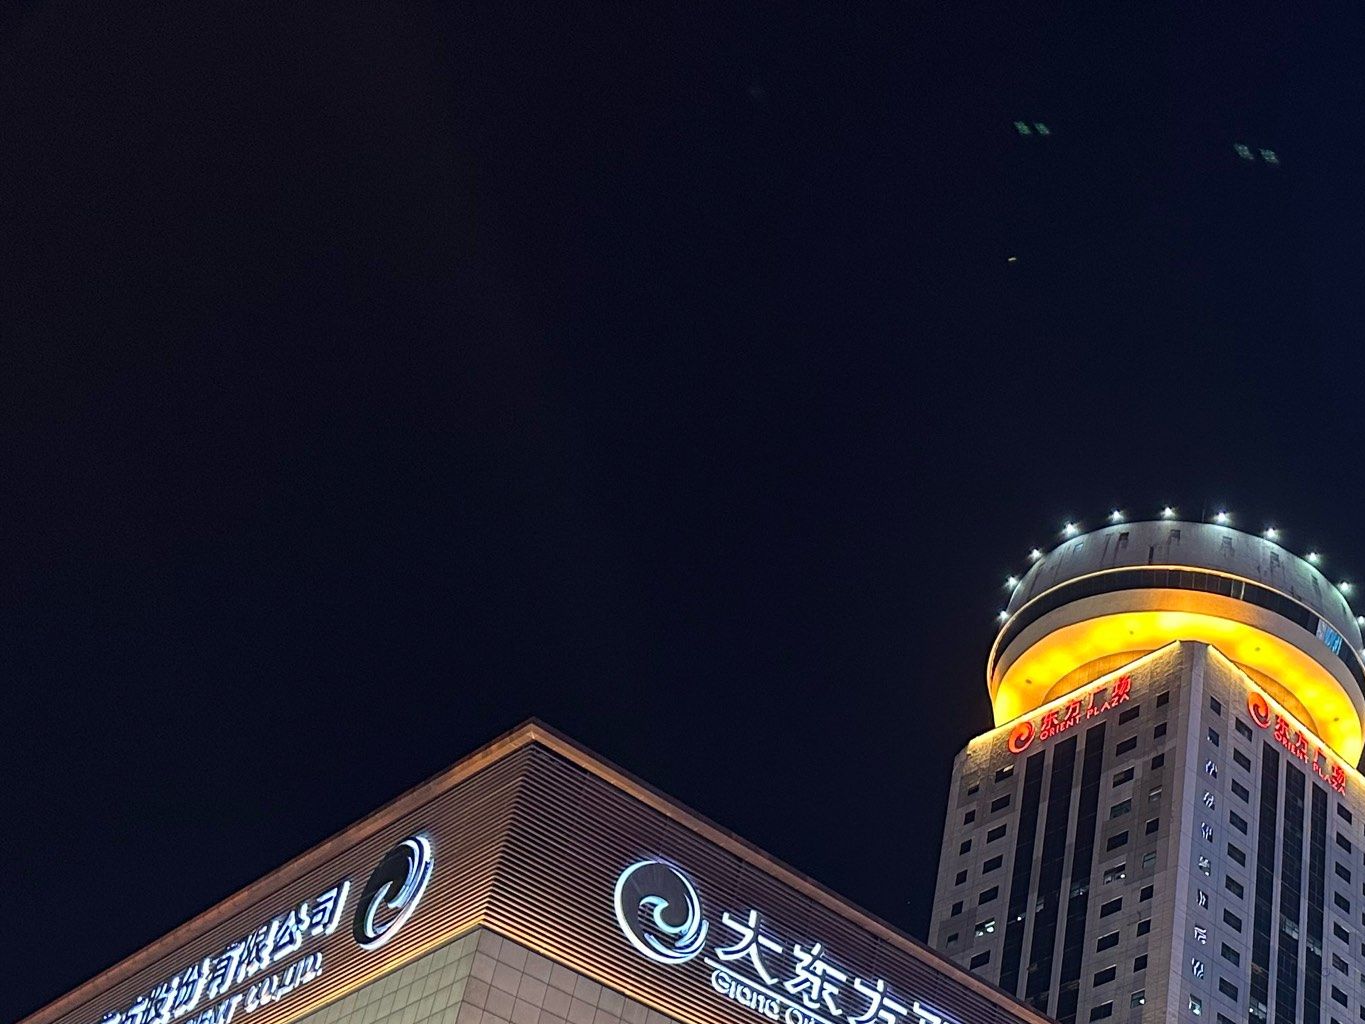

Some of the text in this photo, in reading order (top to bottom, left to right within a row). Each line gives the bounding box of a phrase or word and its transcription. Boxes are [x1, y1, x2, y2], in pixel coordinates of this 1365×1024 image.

[1040, 693, 1130, 740] ORIENT PLAZA
[1041, 674, 1131, 731] 东方广场
[1273, 731, 1346, 797] ORIENT PLAZA
[1274, 713, 1346, 789] 东方广场
[711, 969, 780, 1021] Grand
